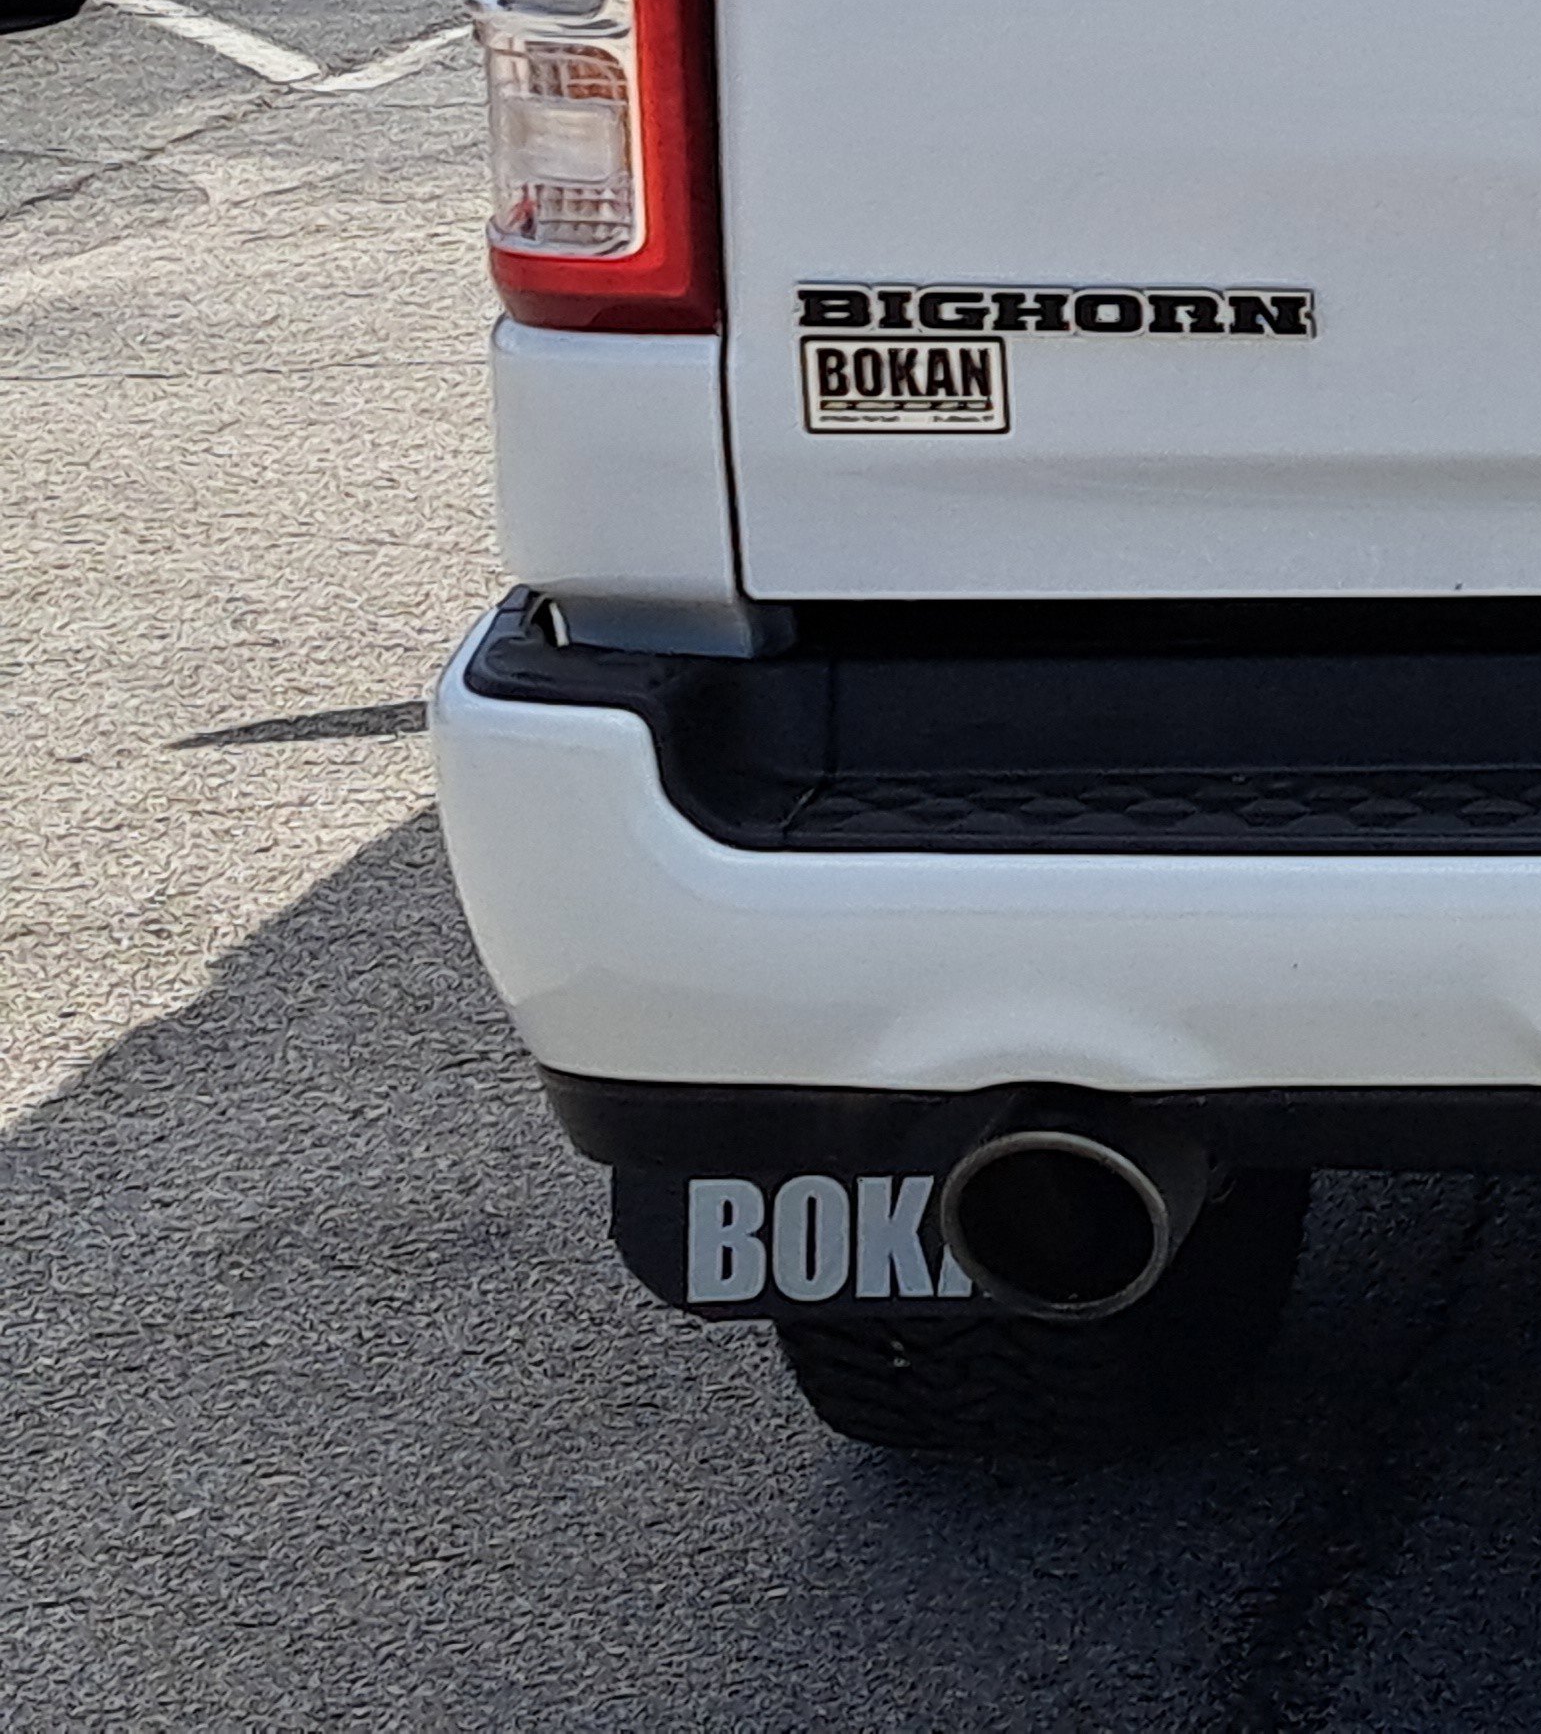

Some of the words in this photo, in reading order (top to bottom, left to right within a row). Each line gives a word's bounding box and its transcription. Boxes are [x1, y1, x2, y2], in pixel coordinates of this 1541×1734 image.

[797, 289, 1307, 334] BIGHORN
[816, 347, 992, 397] BOKAN
[687, 1175, 973, 1303] BOK
